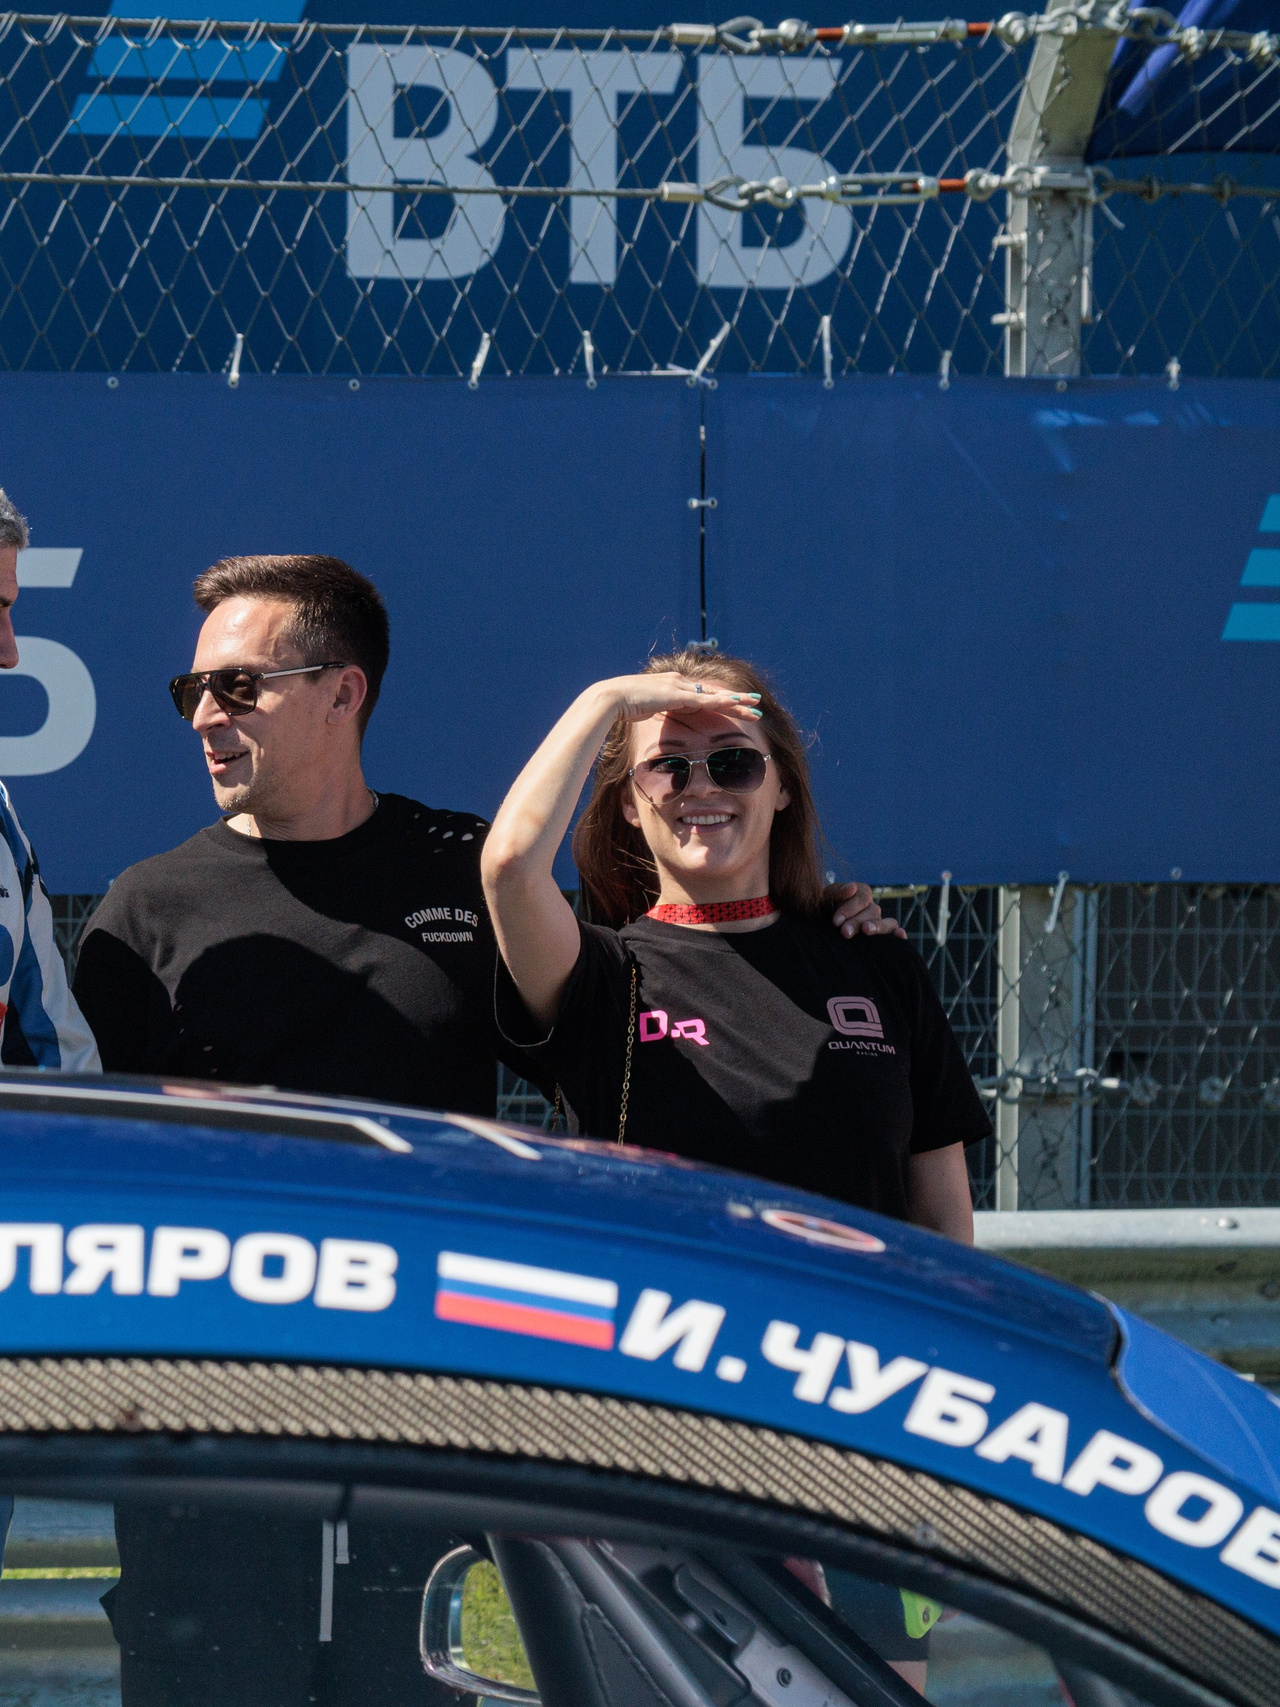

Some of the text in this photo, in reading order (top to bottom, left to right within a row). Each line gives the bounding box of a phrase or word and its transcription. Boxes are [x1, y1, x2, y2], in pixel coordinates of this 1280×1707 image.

[345, 42, 854, 290] ВТБ
[404, 907, 479, 929] COMME DES
[421, 931, 474, 943] FUCKDOWN
[828, 1041, 896, 1055] QUANTUM
